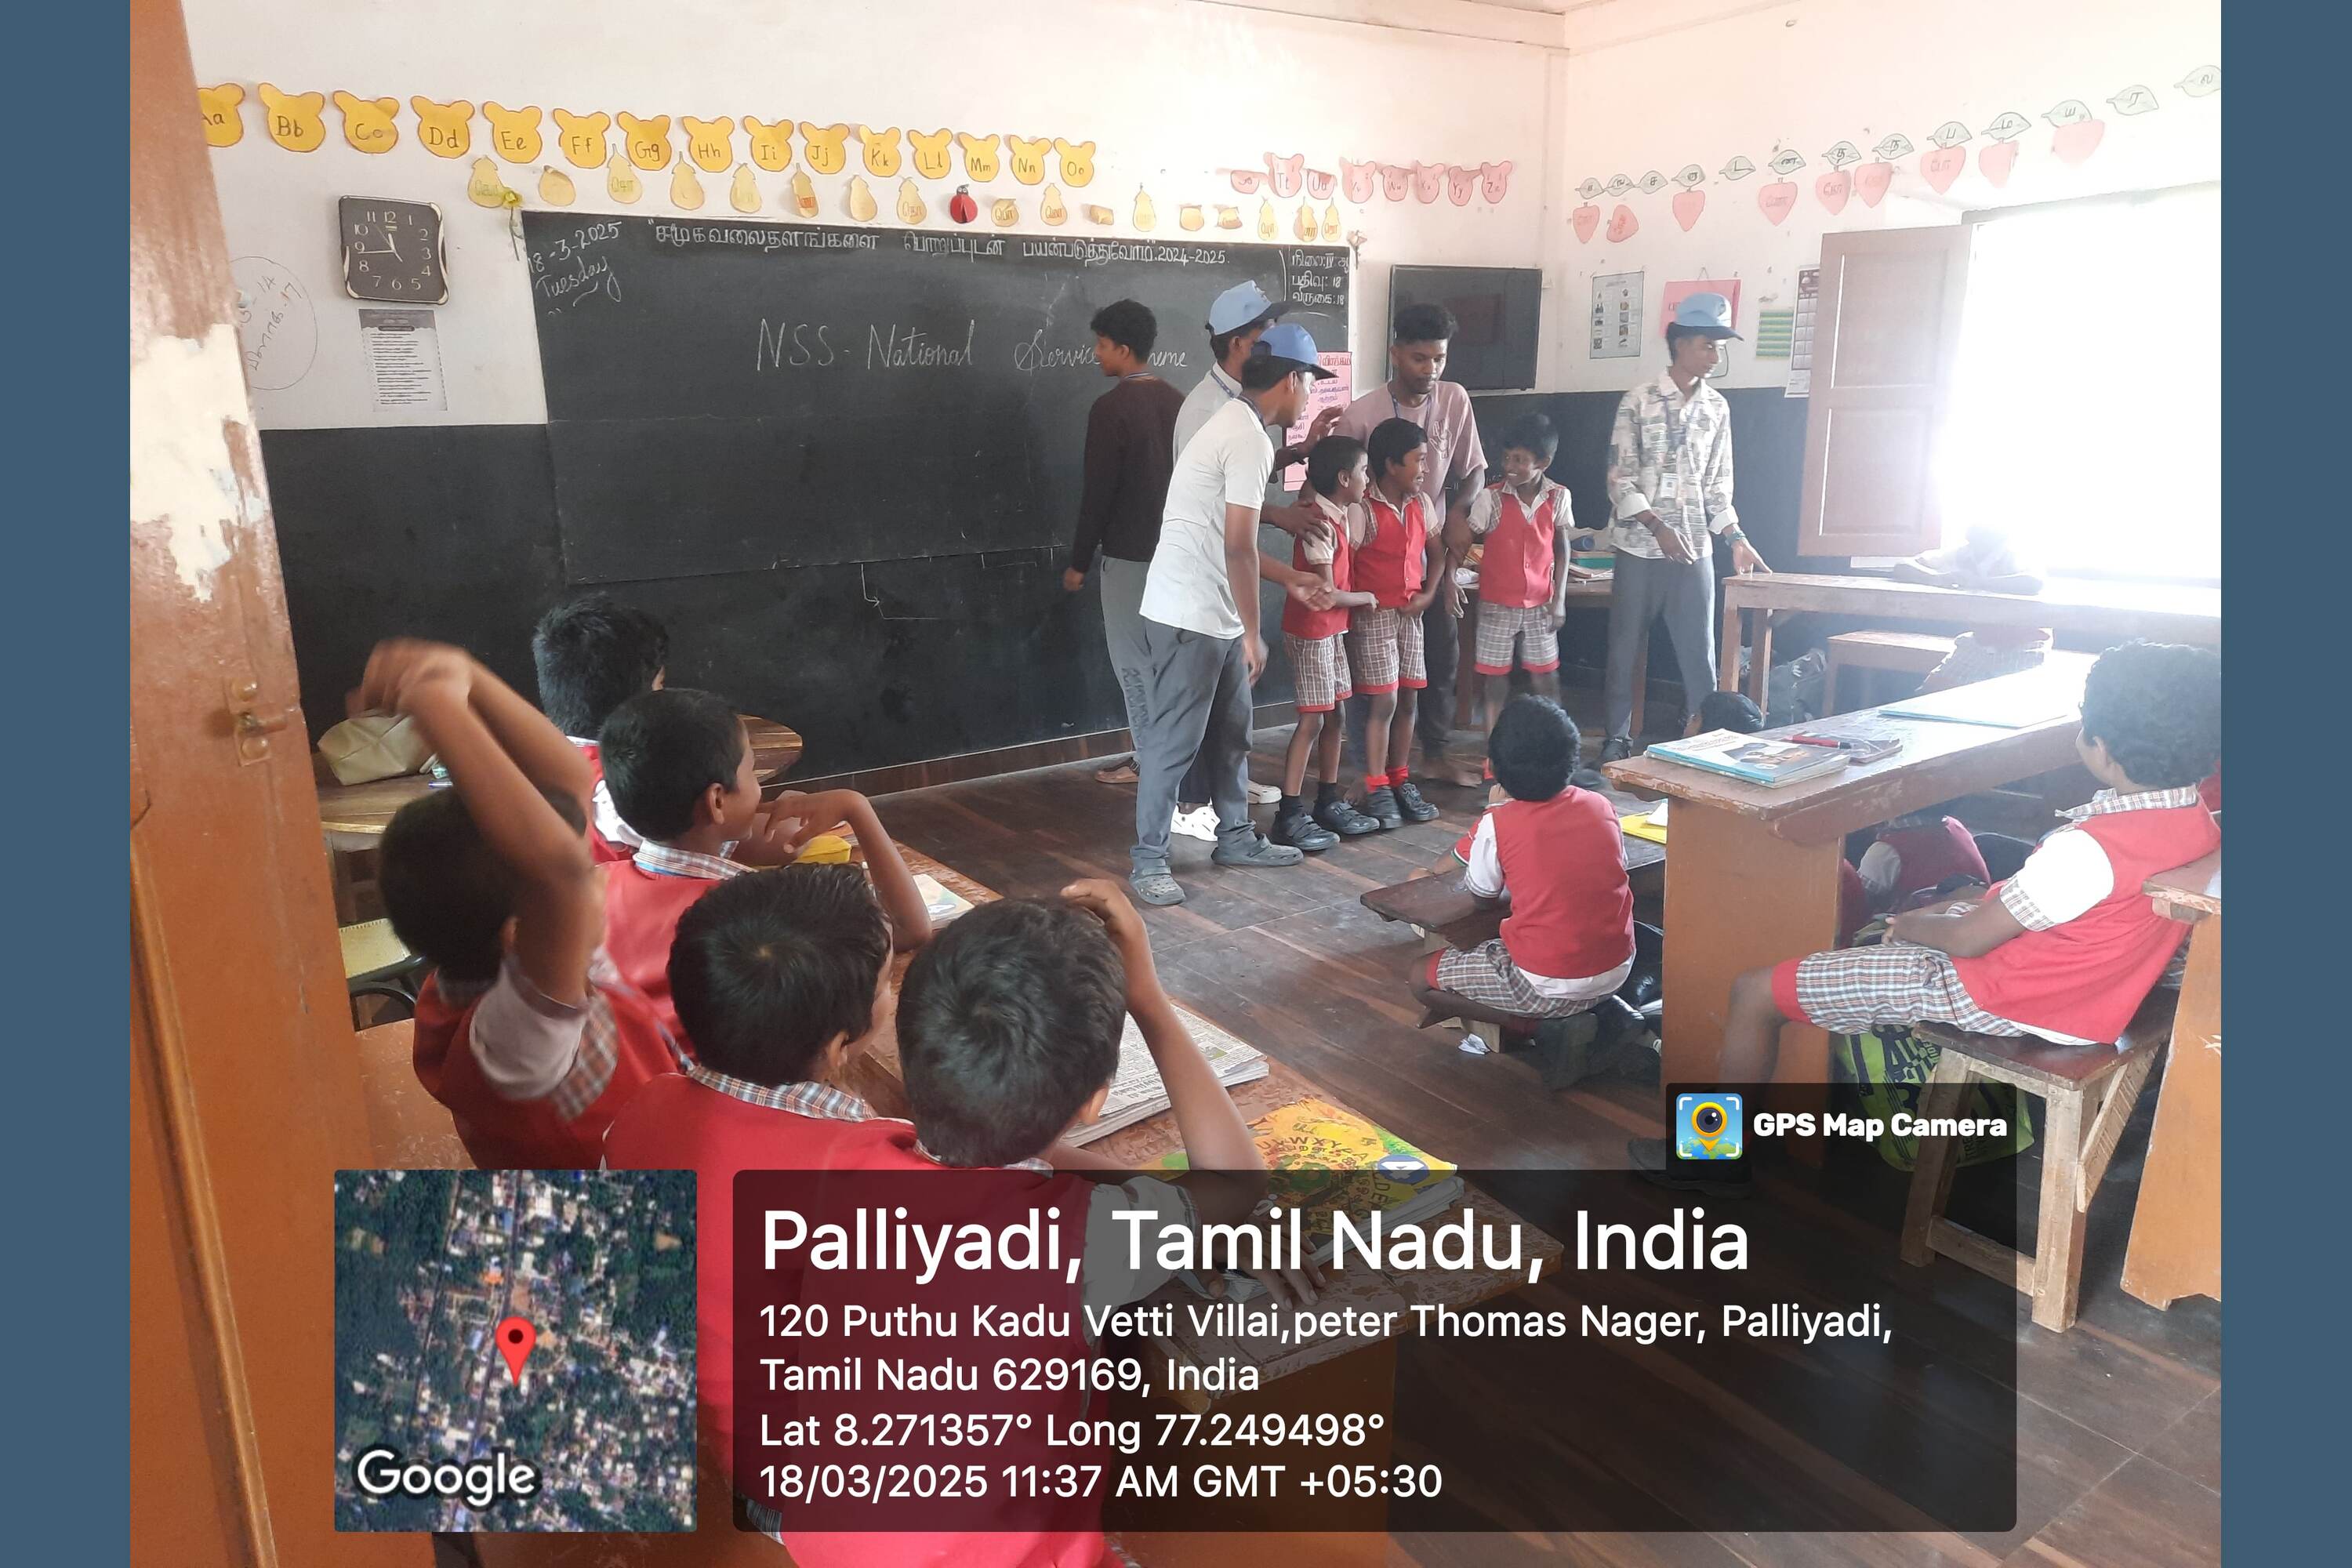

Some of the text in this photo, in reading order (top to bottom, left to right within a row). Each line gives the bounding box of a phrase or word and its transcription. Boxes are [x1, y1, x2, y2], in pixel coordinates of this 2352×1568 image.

[276, 115, 303, 137] Bb
[428, 126, 459, 149] Dd
[501, 131, 527, 151] Ee
[571, 136, 593, 154] Ff
[634, 141, 660, 162] Gg
[698, 143, 720, 159] Hh
[760, 145, 777, 161] Ii
[811, 146, 829, 167] Jj
[871, 147, 889, 167] Kk
[924, 151, 943, 170] Ll
[971, 158, 991, 172] Mm
[1018, 158, 1036, 173] Nn
[1067, 161, 1085, 176] Oo
[1277, 172, 1290, 191] Tt
[1453, 182, 1464, 199] Yy
[367, 211, 376, 223] 11
[384, 211, 397, 223] 12
[408, 214, 413, 226] 1
[354, 223, 369, 236] 10
[419, 228, 429, 241] 2
[354, 241, 365, 252] 9
[423, 247, 432, 260] 3
[359, 260, 369, 273] 8
[420, 265, 431, 277] 4
[372, 275, 382, 288] 7
[392, 278, 402, 290] 6
[411, 278, 422, 290] 5
[535, 256, 622, 303] Tuesday
[1333, 276, 1341, 289] 18
[866, 319, 975, 370] National
[1013, 328, 1101, 376] Service
